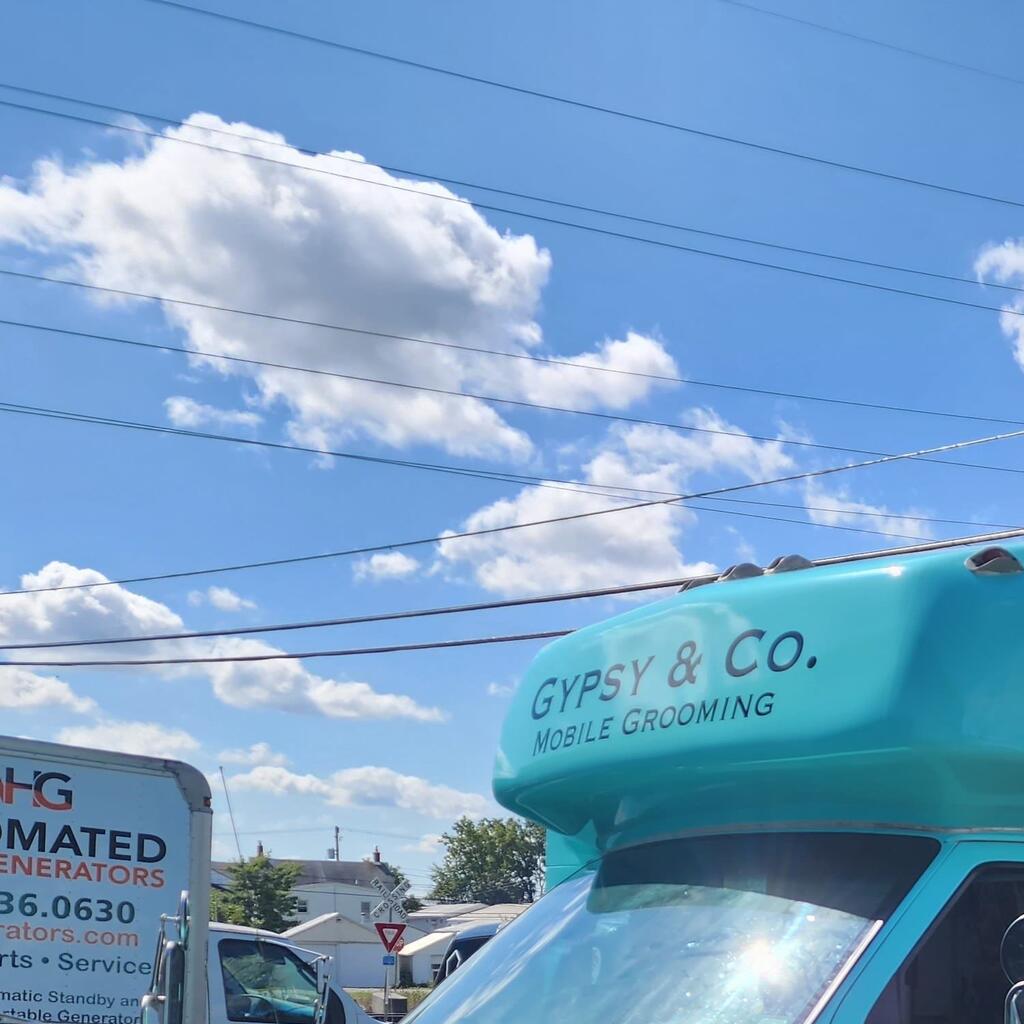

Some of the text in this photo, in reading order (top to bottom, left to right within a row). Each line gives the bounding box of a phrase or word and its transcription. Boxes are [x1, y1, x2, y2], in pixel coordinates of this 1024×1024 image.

[531, 629, 817, 720] GYPSY & CO.
[532, 692, 776, 757] MOBILE GROOMING
[0, 767, 73, 811] HG
[0, 818, 167, 863] MATED
[58, 952, 151, 975] Service
[48, 991, 115, 1009] Standby
[120, 997, 140, 1007] an
